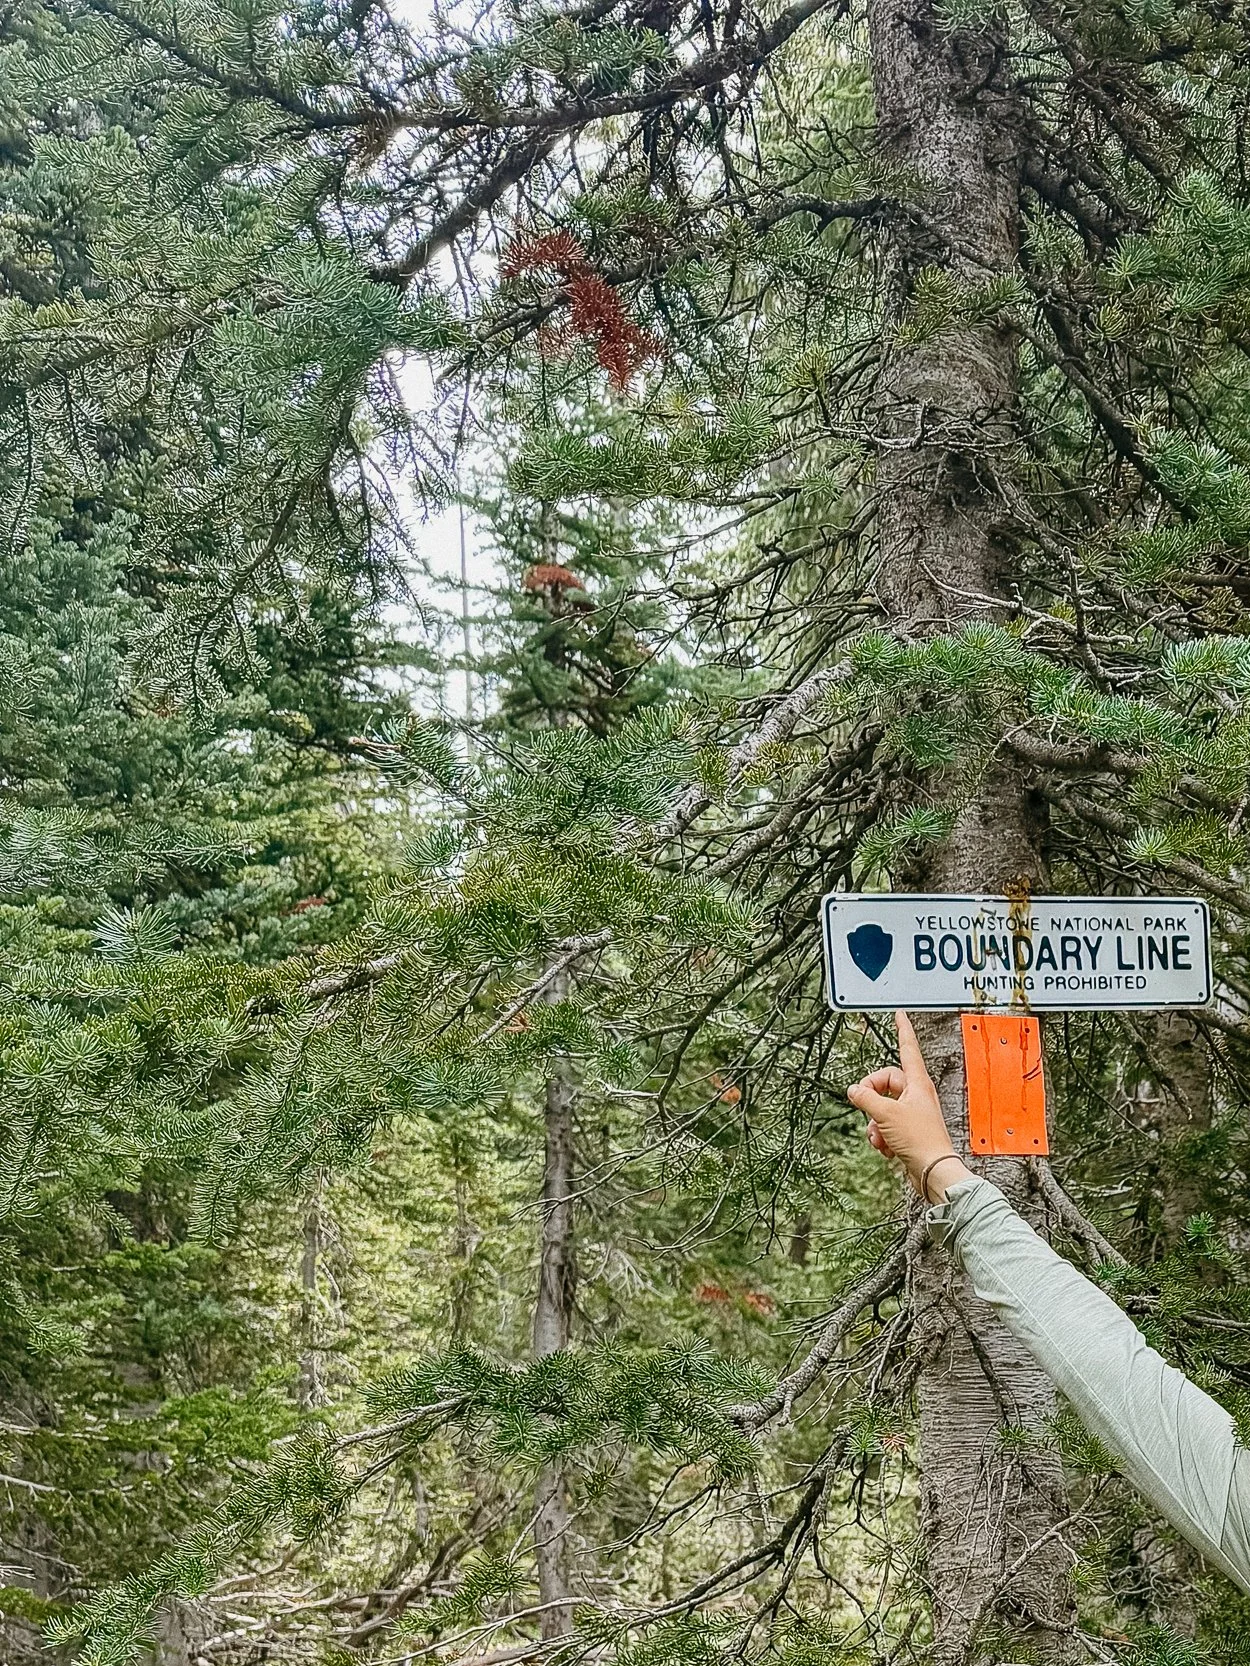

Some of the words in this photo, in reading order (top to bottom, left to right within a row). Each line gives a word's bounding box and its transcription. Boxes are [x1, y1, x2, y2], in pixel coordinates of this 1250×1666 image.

[914, 915, 1040, 931] YELLOWSTONE
[1050, 916, 1135, 931] NATIONAL
[1143, 917, 1187, 931] PARK
[913, 934, 1103, 972] BOUNDARY
[1116, 935, 1192, 971] LINE
[963, 975, 1035, 991] HUNTING
[1044, 975, 1147, 990] PROHIBITED
